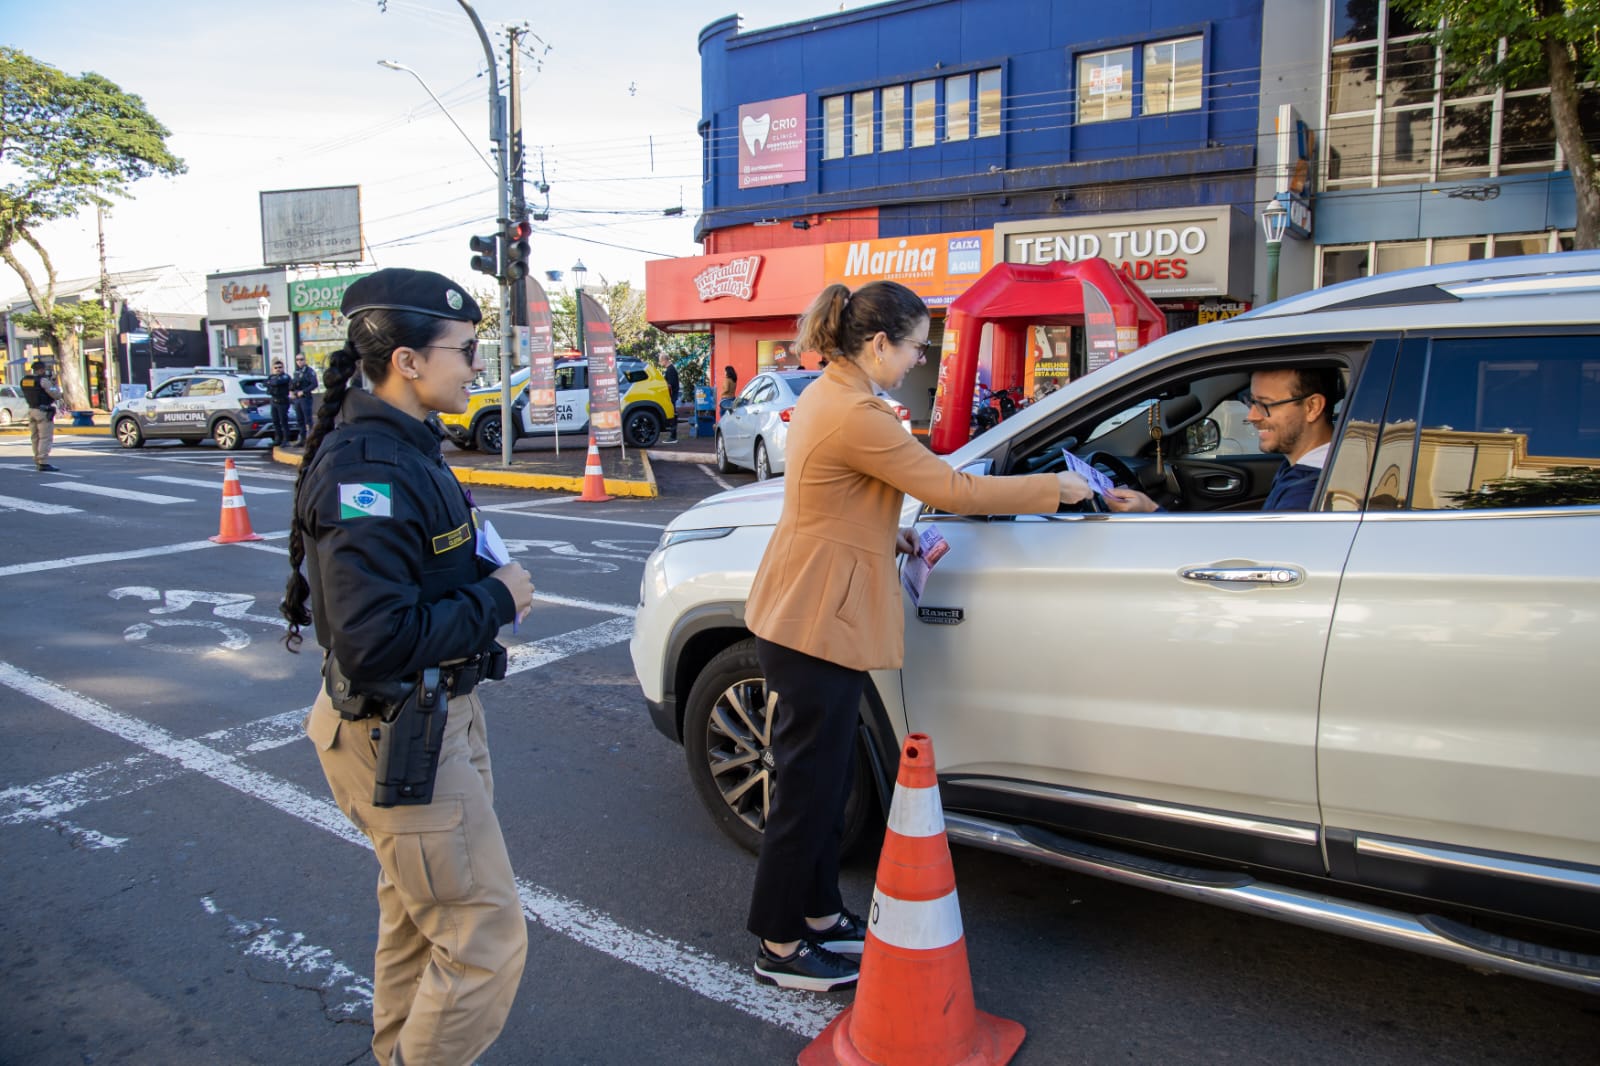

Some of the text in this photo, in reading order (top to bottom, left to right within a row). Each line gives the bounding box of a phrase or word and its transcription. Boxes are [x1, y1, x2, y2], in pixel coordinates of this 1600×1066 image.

[771, 117, 798, 131] CR10
[950, 240, 980, 250] CAIXA
[1015, 226, 1206, 264] TEND TUDO
[844, 240, 937, 276] Marina
[951, 261, 979, 272] AQUI
[164, 412, 206, 422] MUNICIPAL
